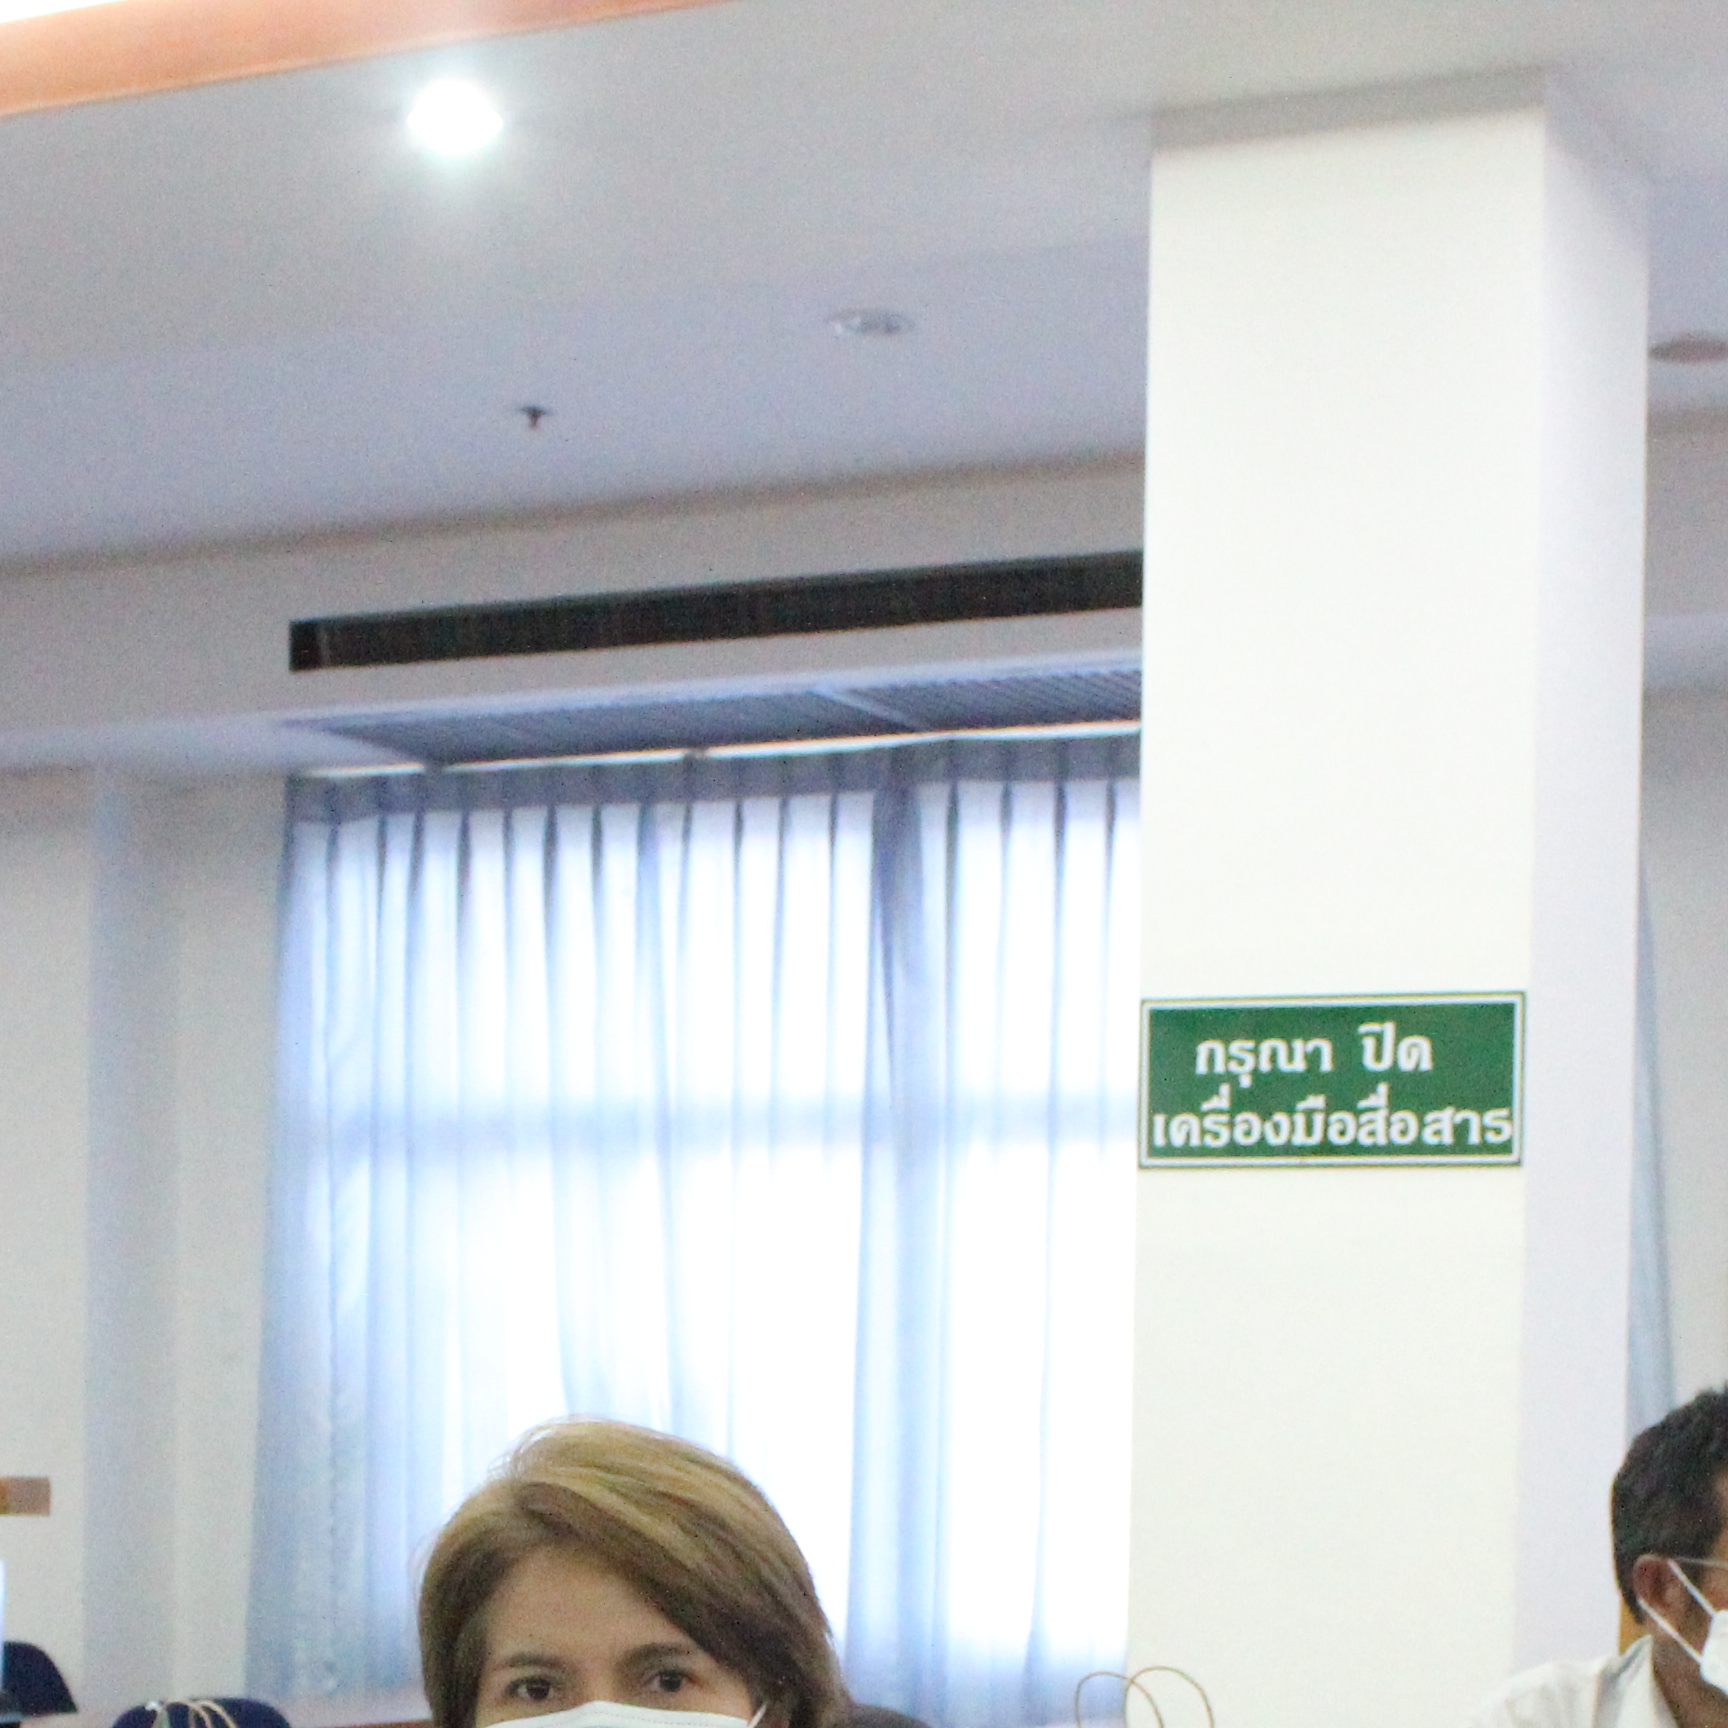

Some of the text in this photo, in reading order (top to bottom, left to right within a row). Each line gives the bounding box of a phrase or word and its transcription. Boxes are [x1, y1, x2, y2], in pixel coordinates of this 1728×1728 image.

[1194, 1021, 1433, 1087] กรุณา ปิด
[1152, 1083, 1514, 1147] เครื่องมือสื่อสาร
